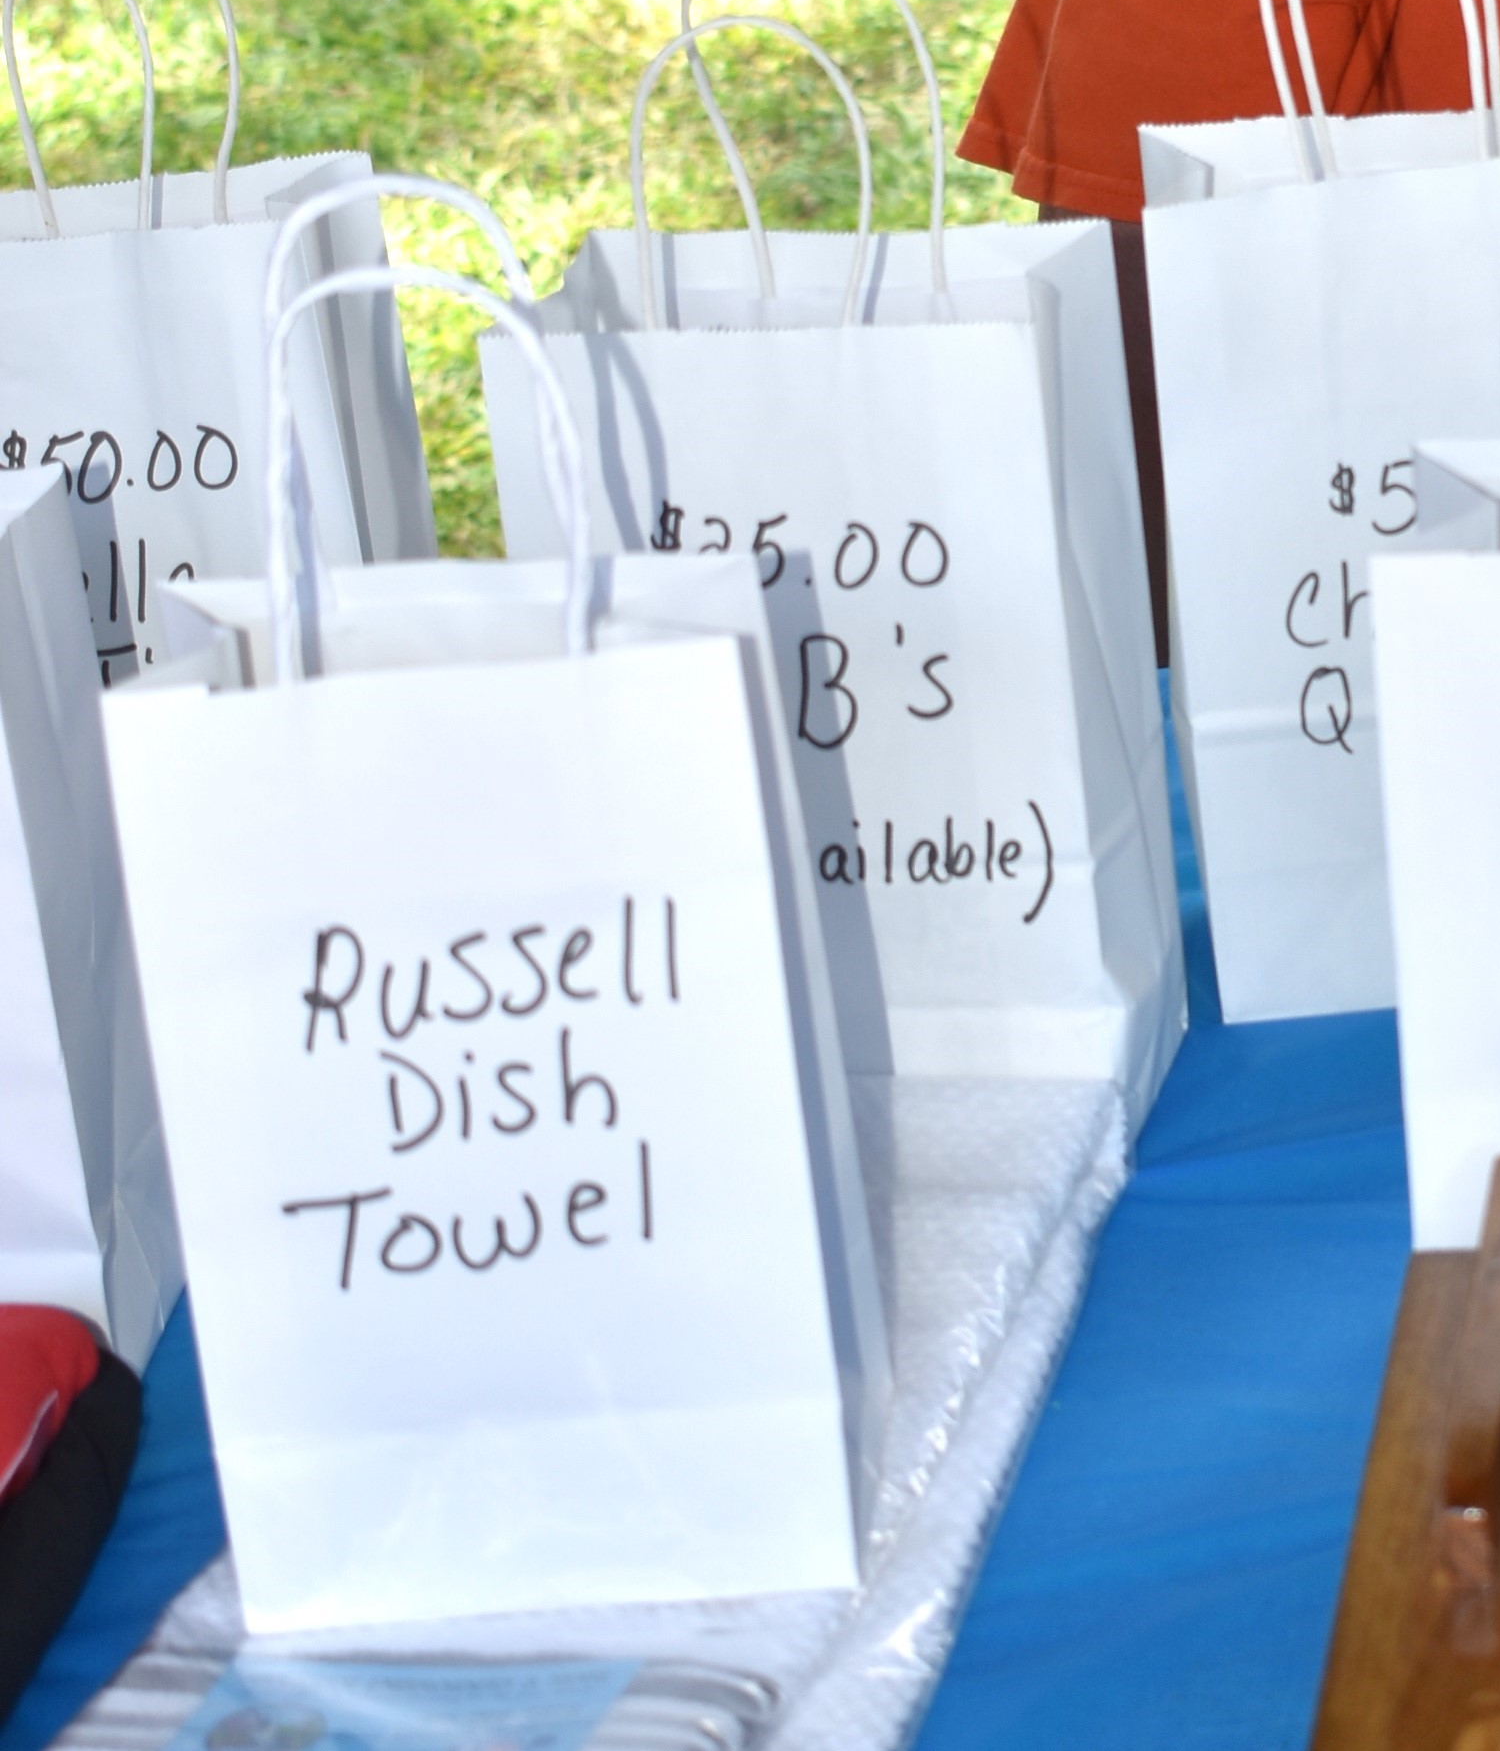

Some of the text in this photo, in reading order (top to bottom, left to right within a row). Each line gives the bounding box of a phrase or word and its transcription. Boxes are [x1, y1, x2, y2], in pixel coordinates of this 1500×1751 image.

[0, 423, 239, 505] $50.00
[301, 894, 681, 1054] Russell
[376, 1025, 621, 1154] Dish
[280, 1137, 656, 1292] Towel
